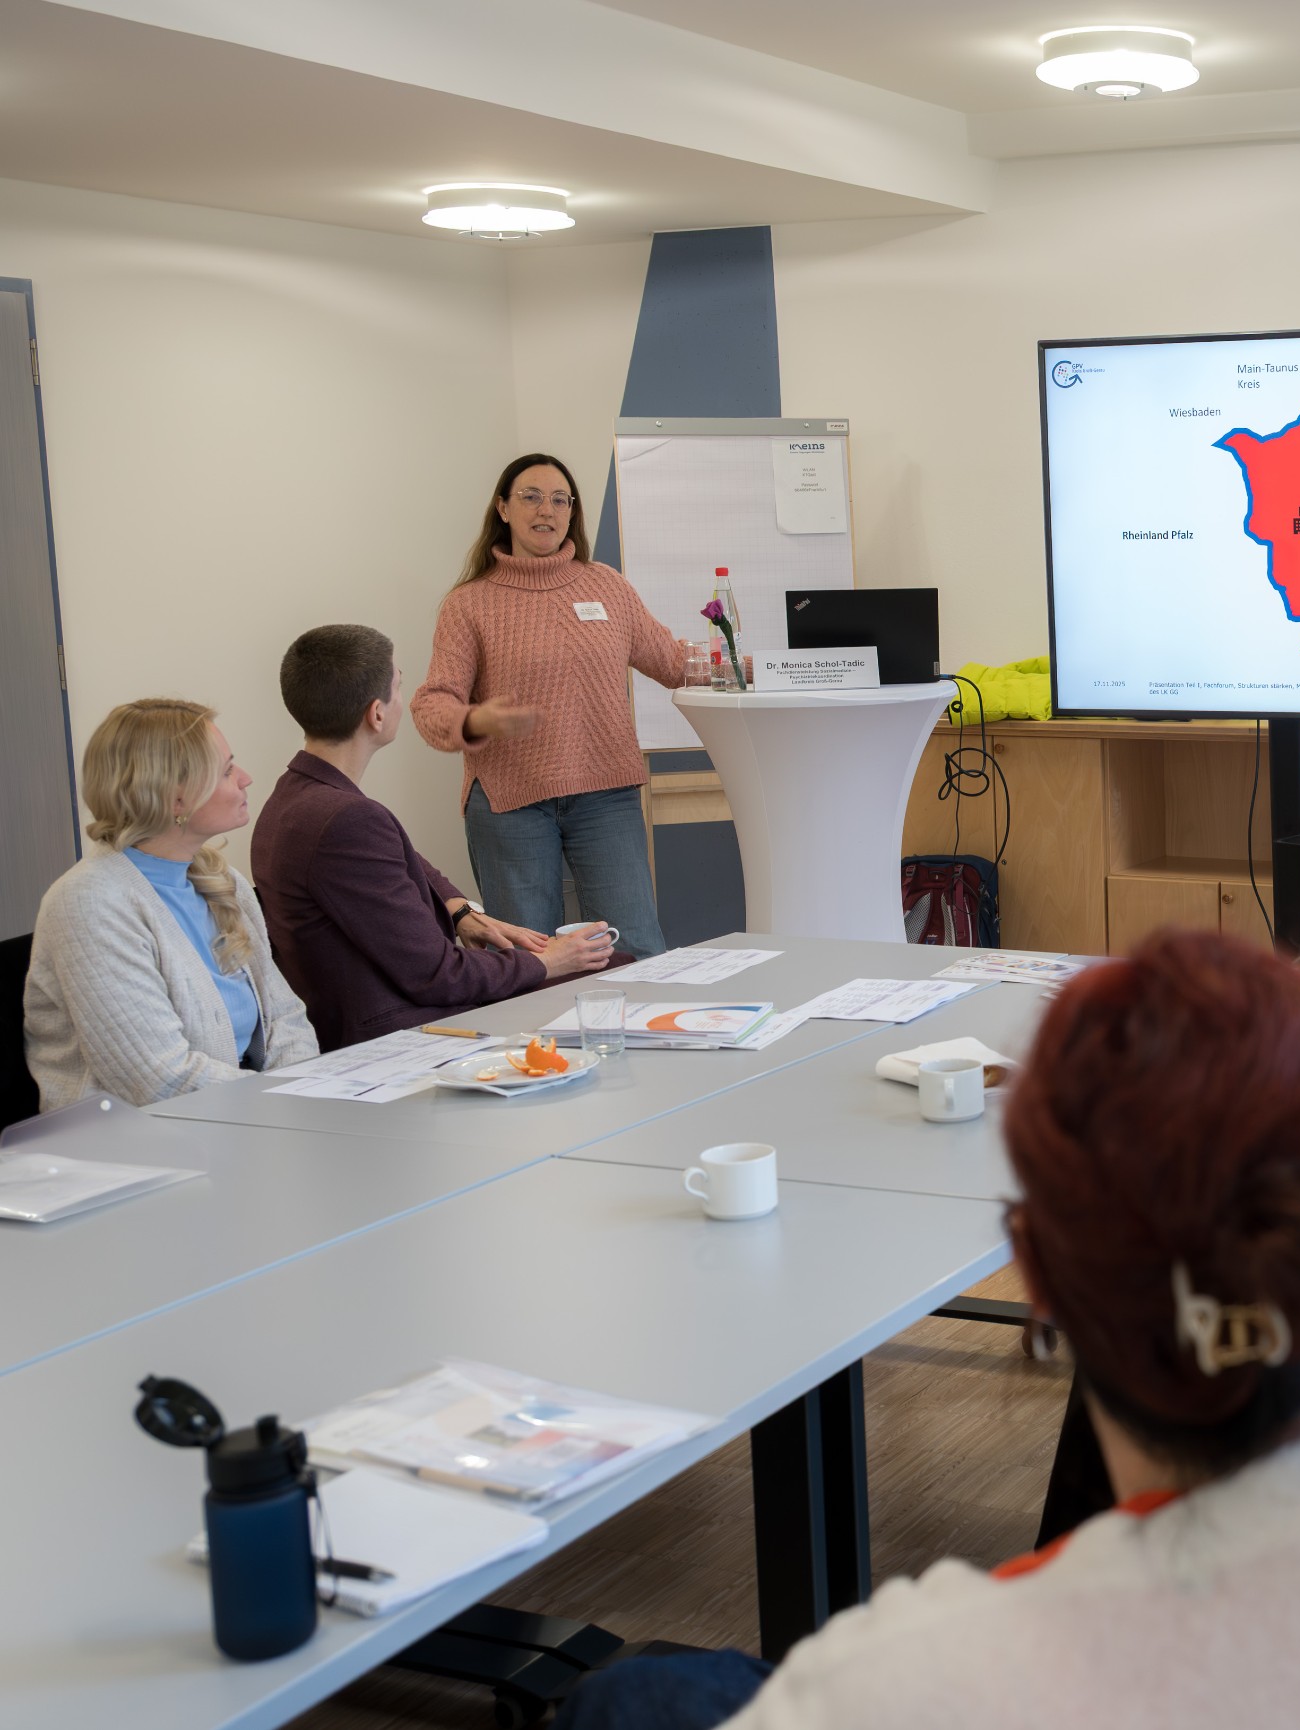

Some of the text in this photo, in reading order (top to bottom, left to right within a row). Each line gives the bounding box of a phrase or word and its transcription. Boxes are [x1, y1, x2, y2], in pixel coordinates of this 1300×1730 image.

[1237, 363, 1299, 374] Main-Taunus
[1237, 379, 1261, 389] Kreis
[1169, 407, 1221, 418] Wiesbaden
[1122, 530, 1194, 540] Rheinland Pfalz
[766, 660, 865, 670] Dr. Monica Schol-Tadic
[1203, 682, 1236, 690] Fachforum,
